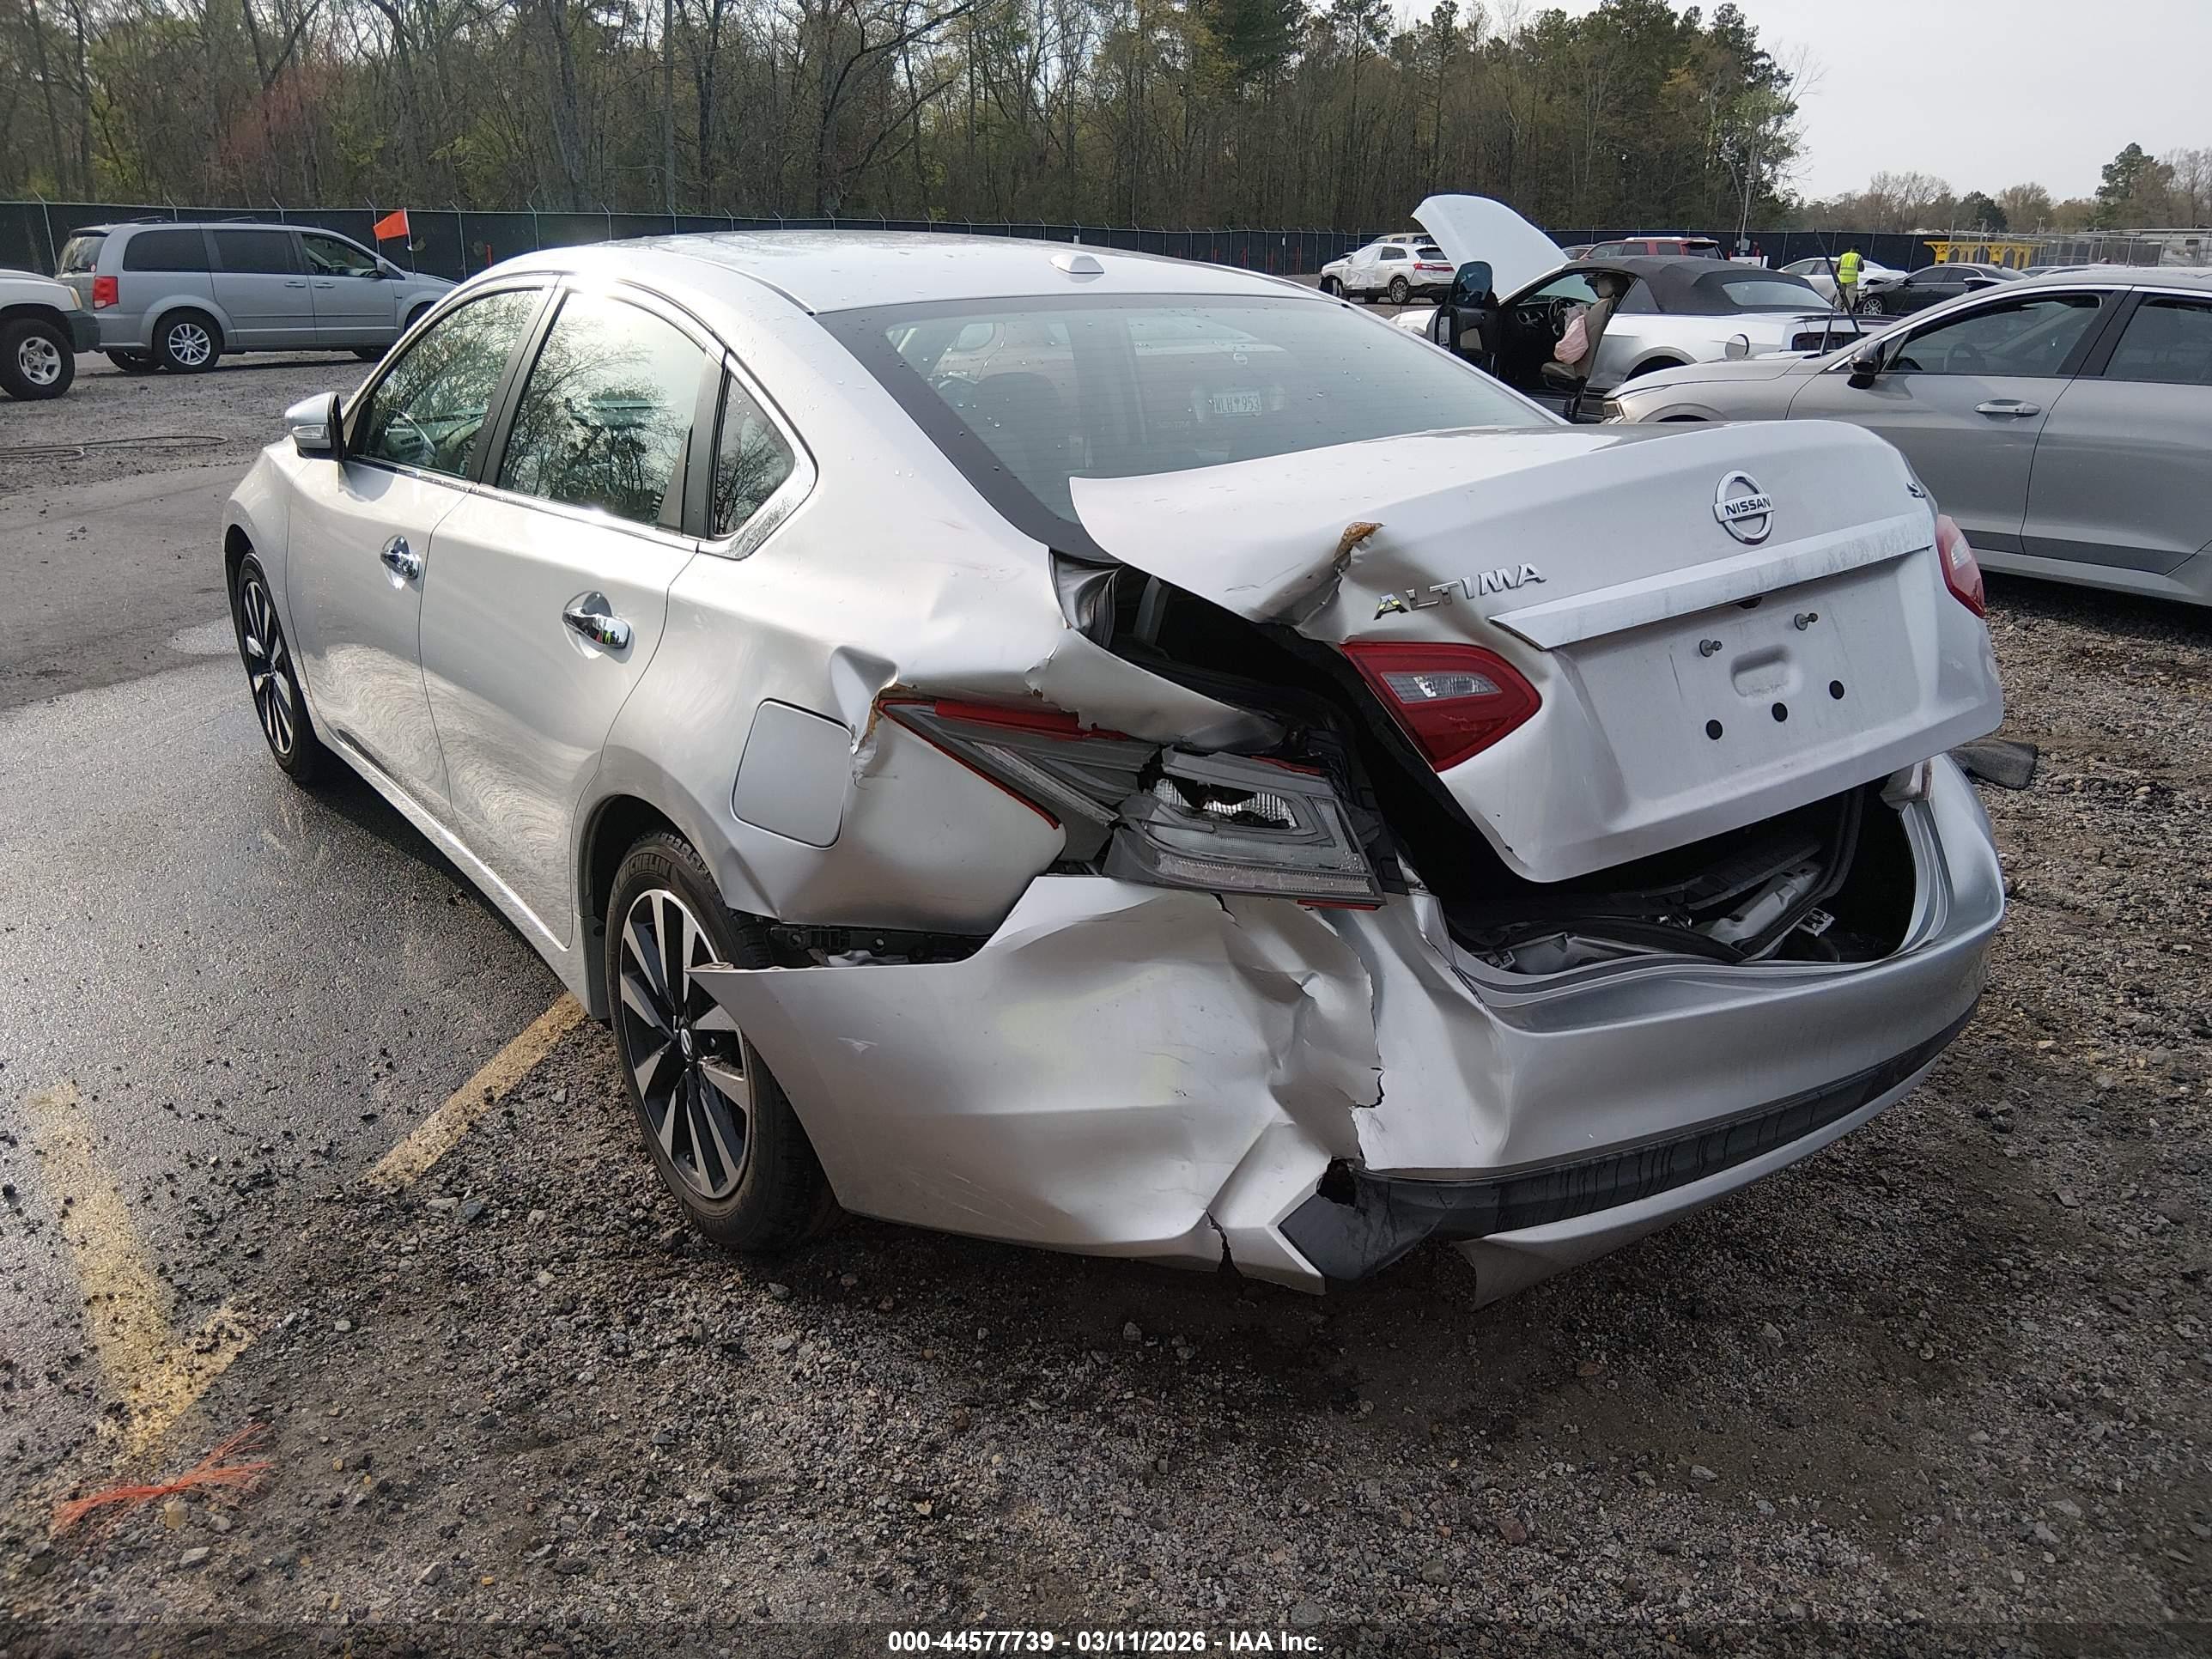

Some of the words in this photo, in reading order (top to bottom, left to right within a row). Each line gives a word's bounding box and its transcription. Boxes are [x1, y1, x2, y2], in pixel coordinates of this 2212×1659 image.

[1725, 497, 1771, 516] NISSAN
[1374, 562, 1547, 620] ALTIMA
[618, 854, 671, 888] MICHELIN
